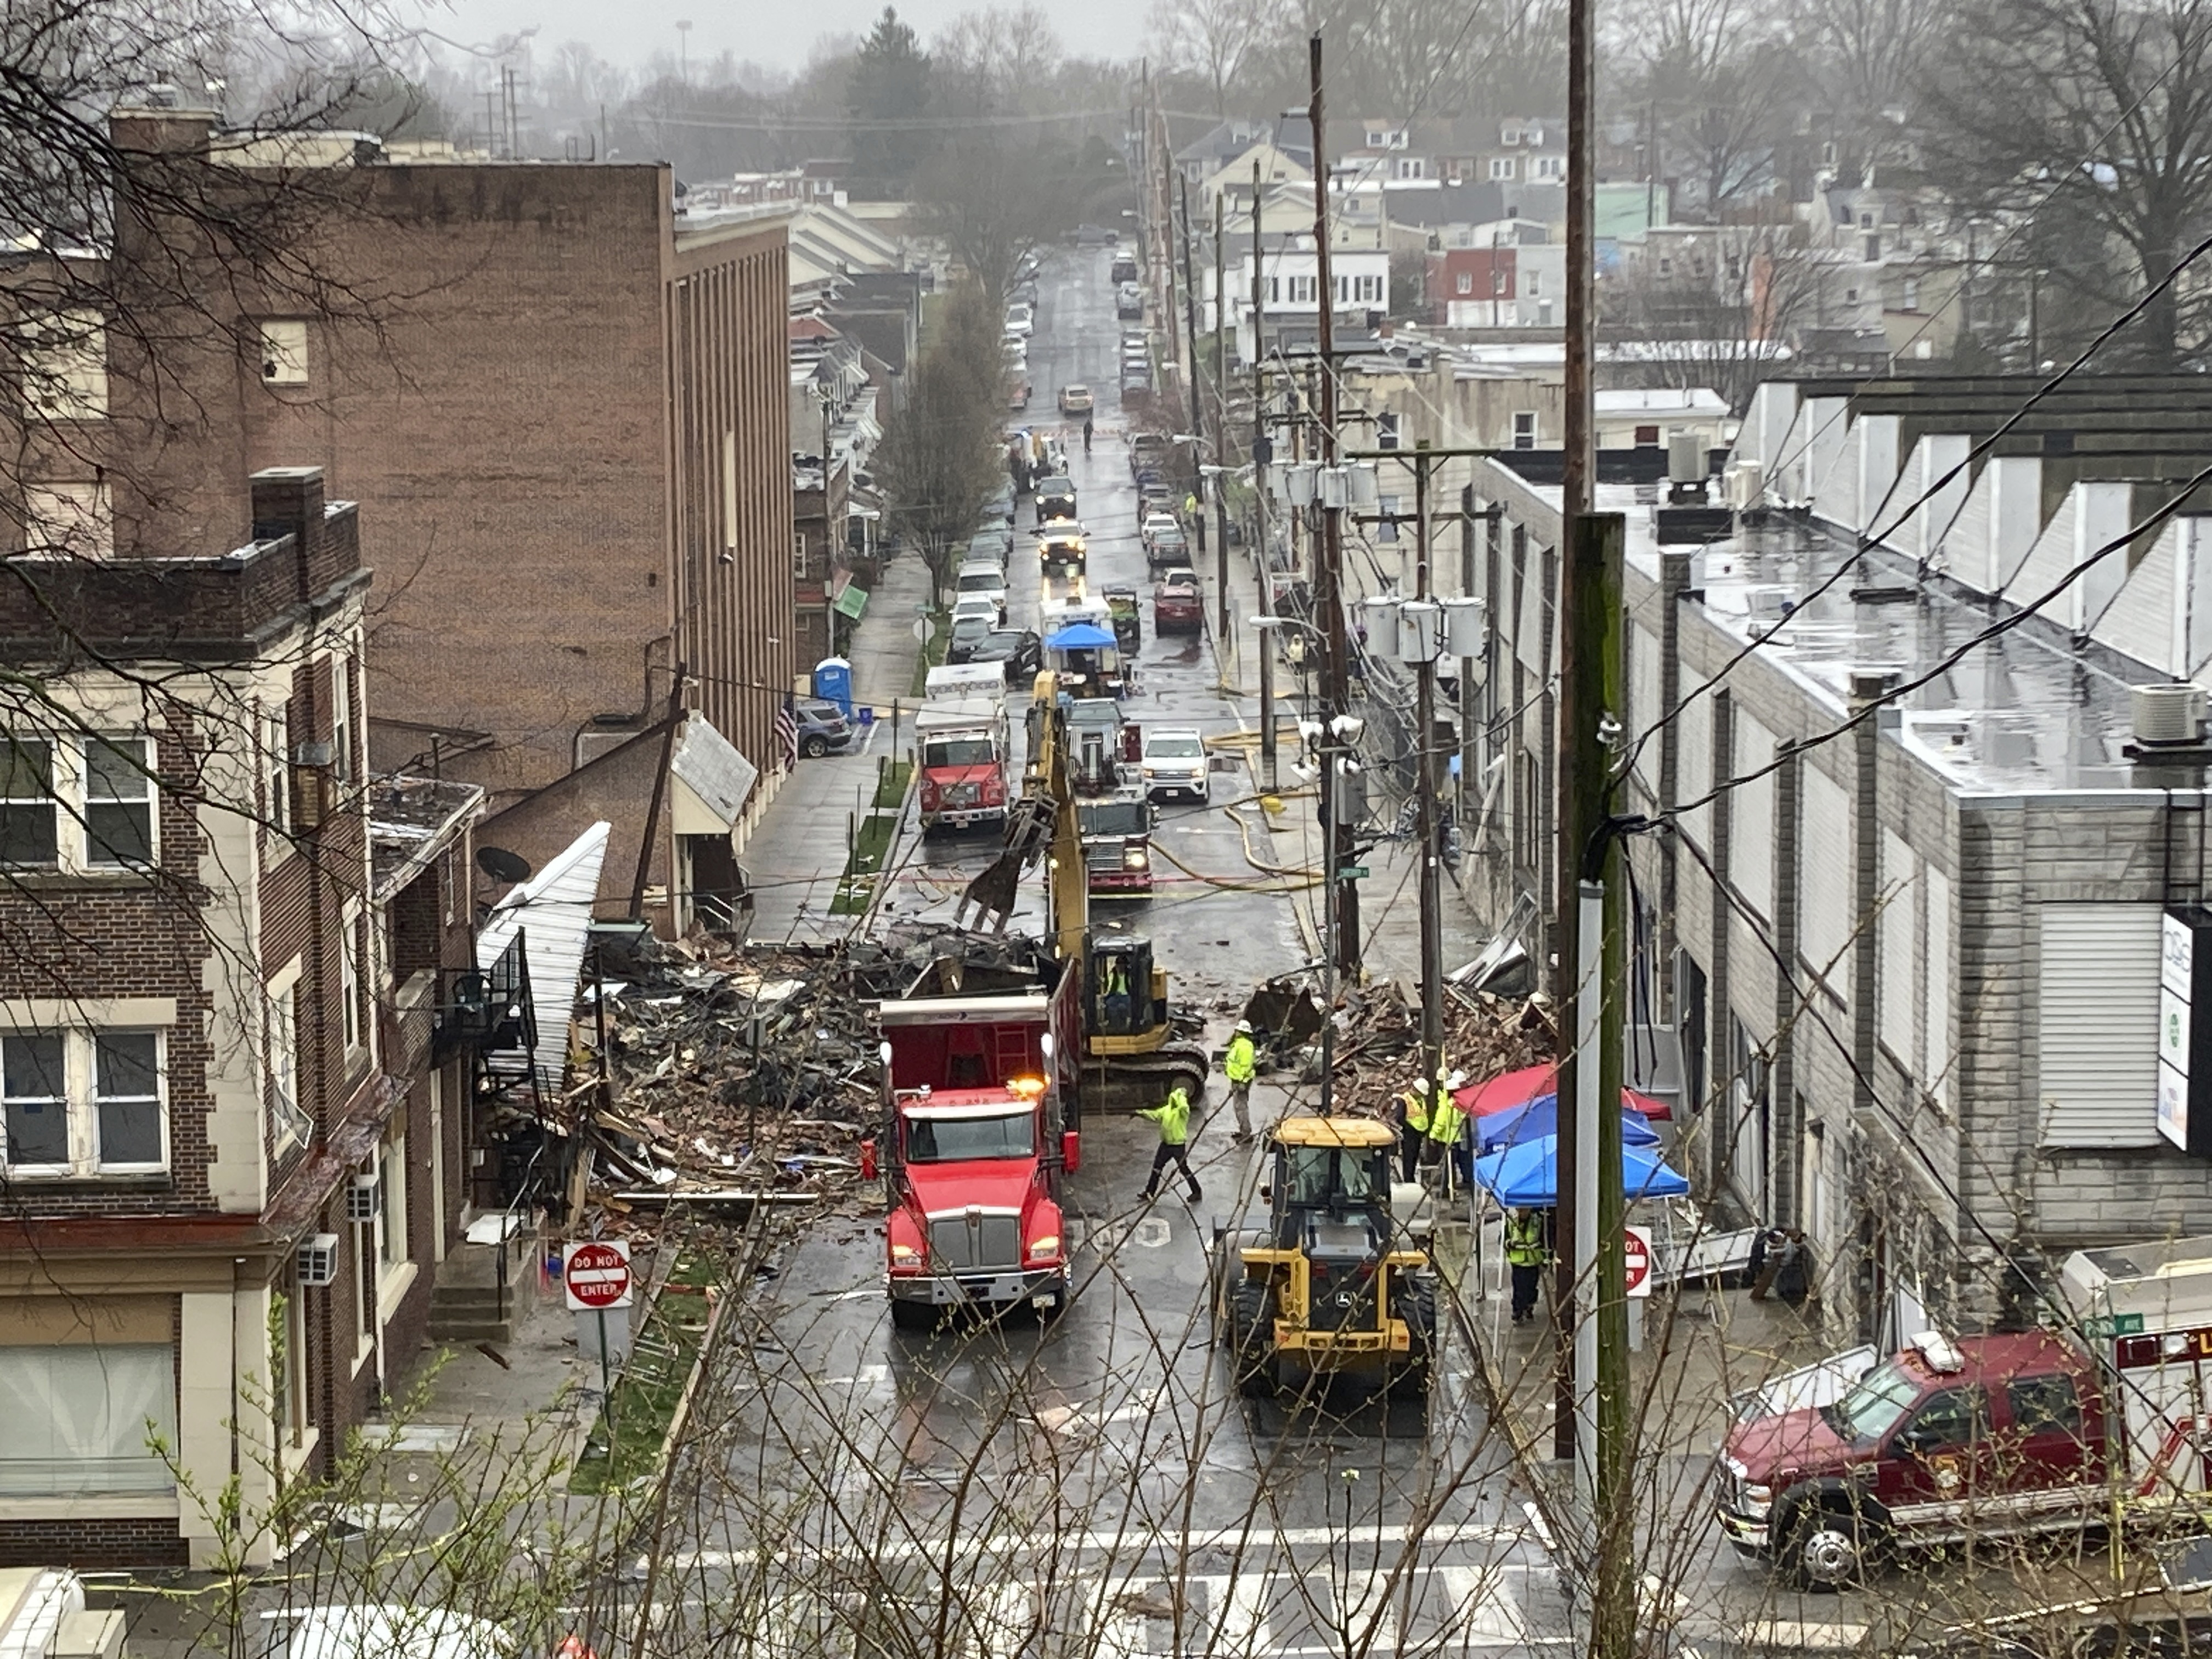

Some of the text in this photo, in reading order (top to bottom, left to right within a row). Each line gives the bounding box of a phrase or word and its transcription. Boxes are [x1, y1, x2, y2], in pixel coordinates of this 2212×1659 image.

[574, 1254, 619, 1268] DO NOT
[580, 1284, 618, 1296] ENTER
